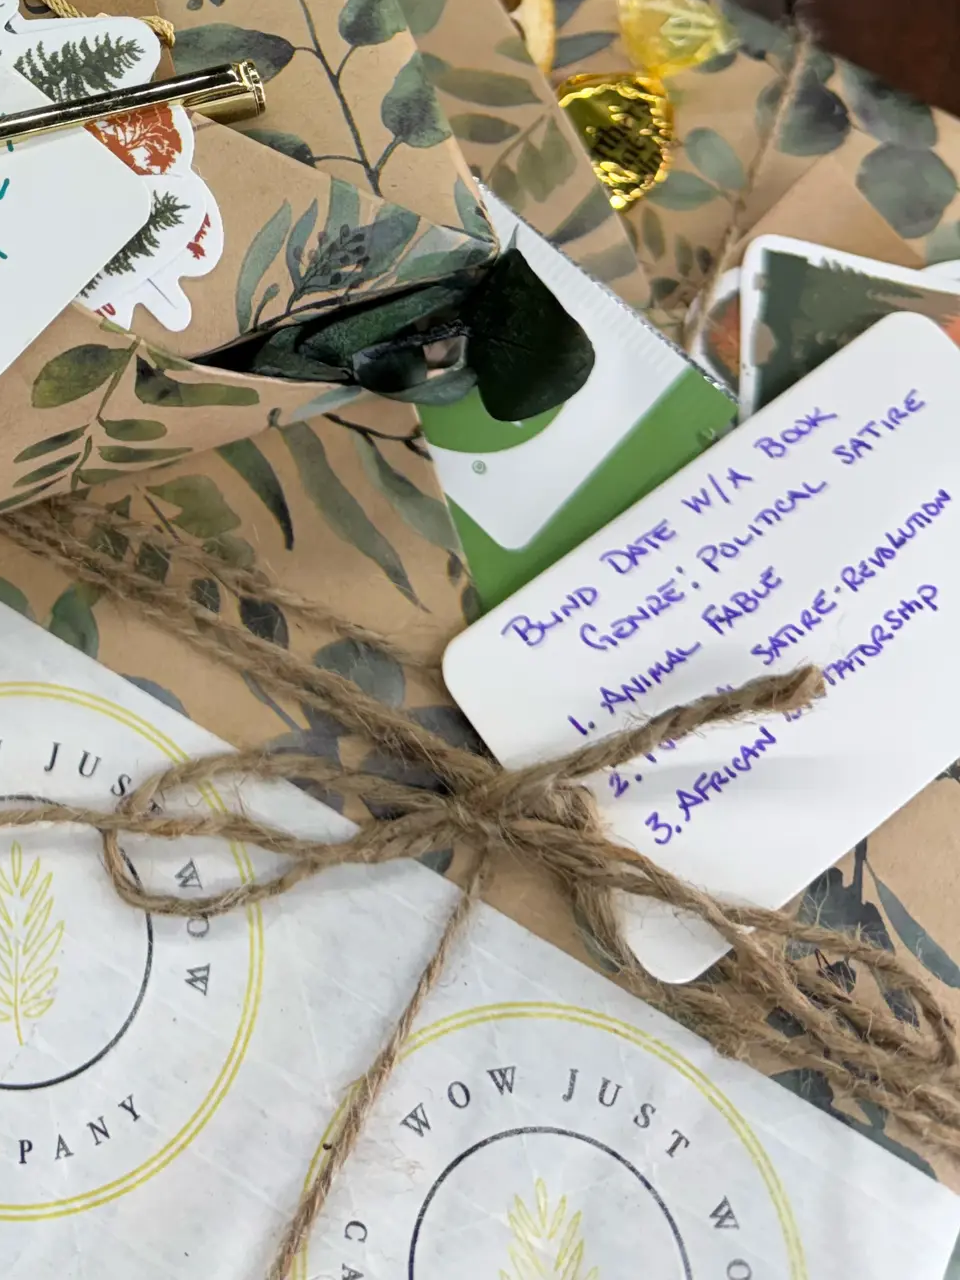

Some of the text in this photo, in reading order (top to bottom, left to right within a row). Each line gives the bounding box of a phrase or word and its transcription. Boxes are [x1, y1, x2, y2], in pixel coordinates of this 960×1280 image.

[500, 584, 599, 648] BLIND
[599, 518, 677, 577] DATE
[753, 406, 839, 461] BOOK
[579, 389, 927, 652] GENRE: POLITICAL SATIRE
[566, 714, 596, 738] 1.
[598, 640, 703, 716] ANIMAL
[700, 565, 784, 636] FABLE
[608, 769, 643, 800] 2.
[644, 810, 684, 846] 3.
[674, 725, 778, 823] AFRICAN
[174, 857, 212, 997] WOW
[400, 1064, 755, 1280] WOW JUST WO
